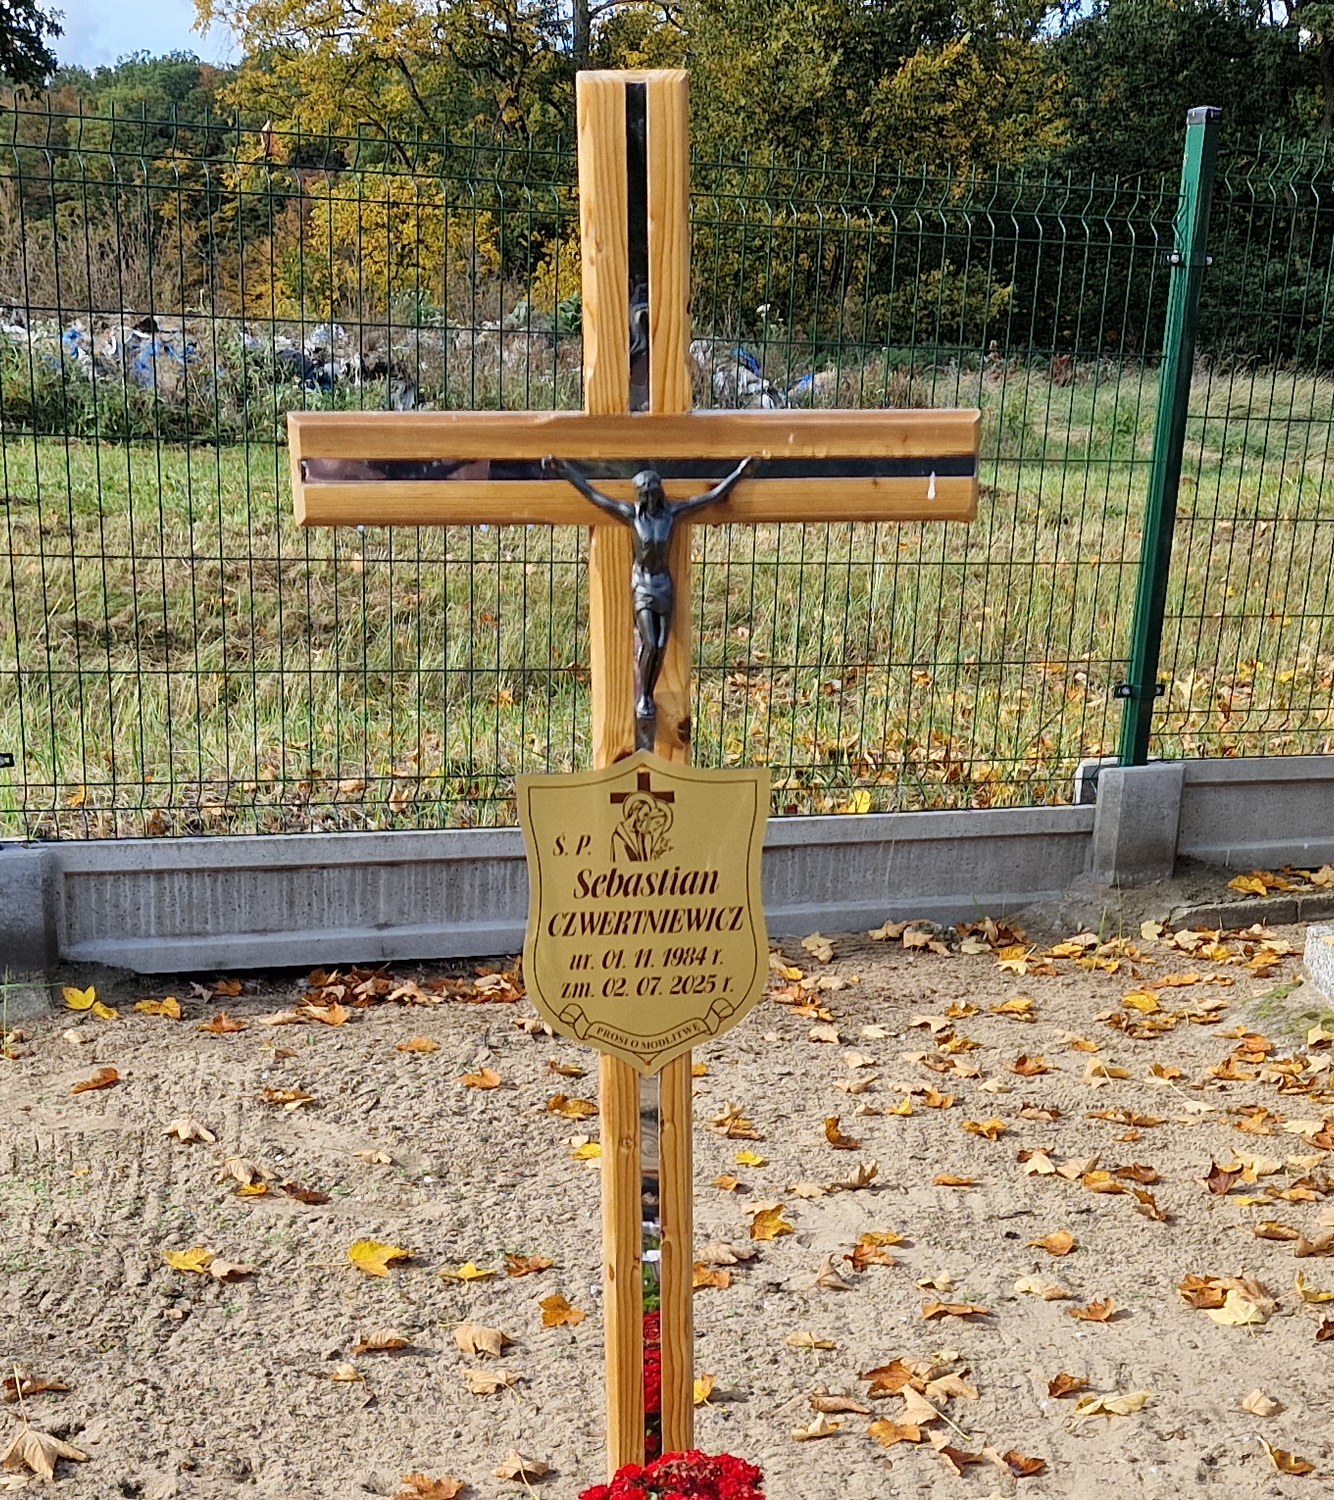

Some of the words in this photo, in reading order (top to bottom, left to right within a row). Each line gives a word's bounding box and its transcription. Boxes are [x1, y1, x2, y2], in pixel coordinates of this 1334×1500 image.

[576, 834, 591, 856] P.
[573, 866, 719, 900] Sebastian
[548, 906, 744, 938] CZWERTNIEWICZ
[569, 953, 595, 971] ur.
[601, 949, 627, 970] 01.
[634, 948, 655, 969] 11.
[662, 946, 709, 968] 1984
[712, 948, 724, 966] r.
[560, 980, 595, 999] zm.
[601, 977, 629, 998] 02.
[636, 976, 663, 997] 07.
[669, 974, 718, 995] 2025
[722, 975, 734, 993] r.
[596, 1026, 629, 1046] PROSI
[630, 1038, 640, 1049] O
[640, 1022, 701, 1050] MODLITWĘ
